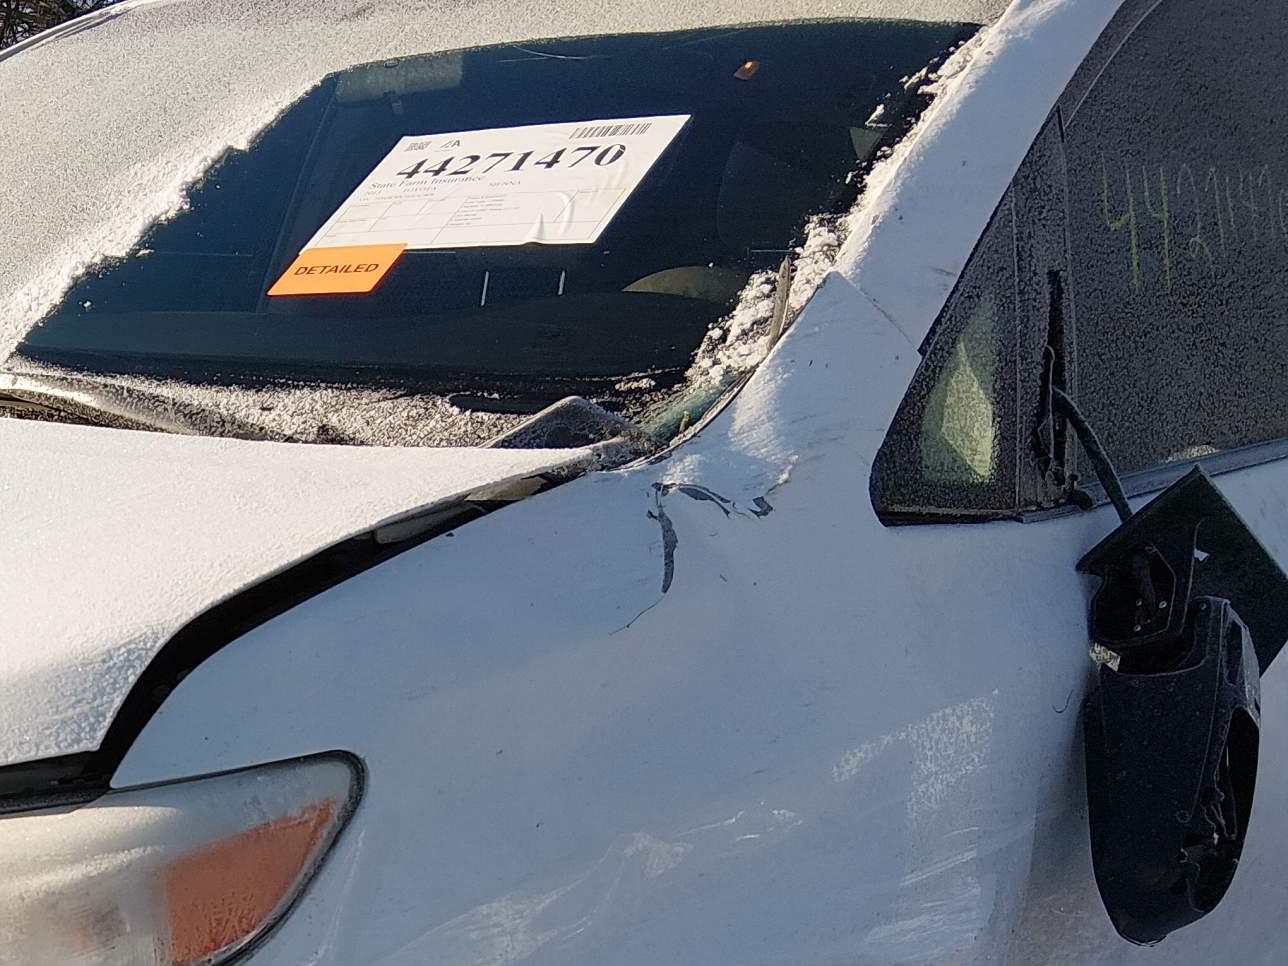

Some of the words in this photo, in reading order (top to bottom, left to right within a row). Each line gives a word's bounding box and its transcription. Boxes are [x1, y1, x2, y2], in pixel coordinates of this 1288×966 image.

[396, 143, 627, 180] 44271470
[370, 182, 397, 190] State
[399, 180, 428, 188] Farm
[430, 175, 484, 185] Insurance
[294, 263, 379, 276] DETAILED
